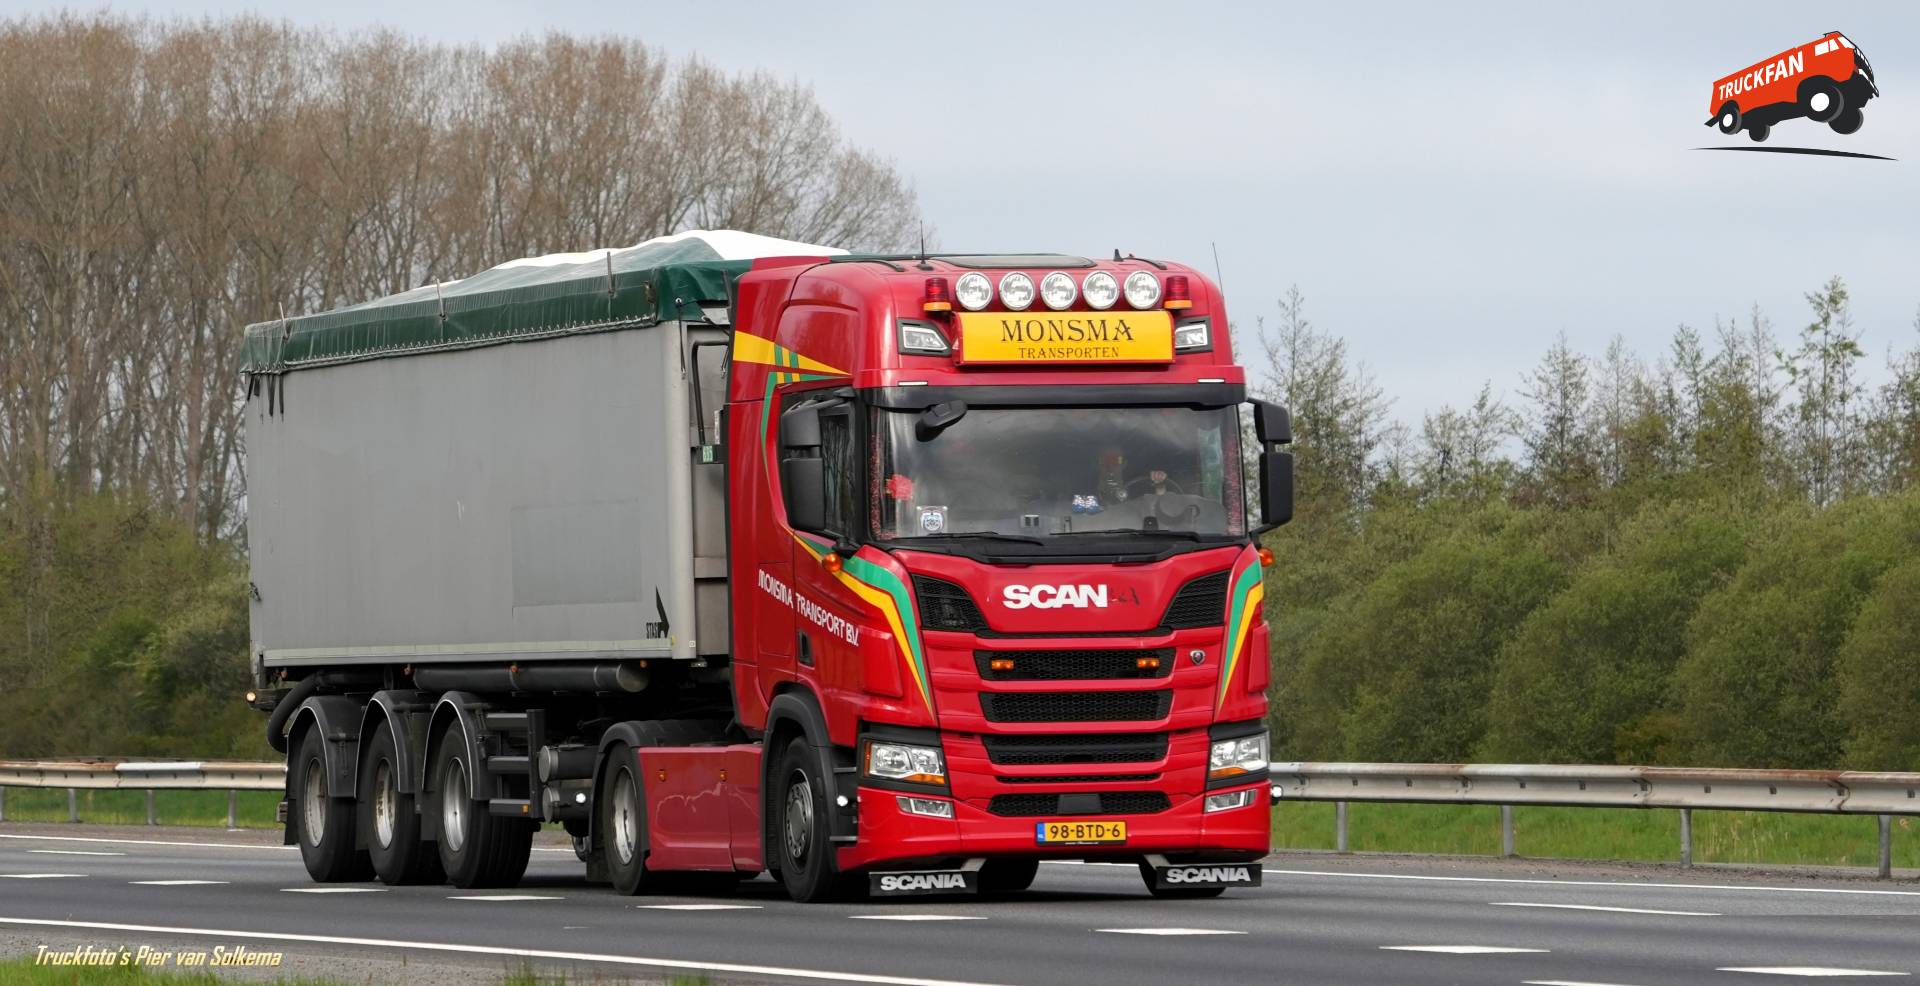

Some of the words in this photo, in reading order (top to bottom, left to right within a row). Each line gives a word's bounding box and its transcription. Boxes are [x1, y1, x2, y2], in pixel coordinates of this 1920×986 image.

[1001, 319, 1134, 342] MONSMA
[1018, 347, 1120, 359] TRANSPORTEN
[758, 568, 794, 610] MONSMA
[795, 591, 845, 639] TRANSPORT
[1050, 824, 1121, 839] 98-BTD-6
[880, 873, 967, 891] SCANIA
[1166, 867, 1252, 884] SCANIA
